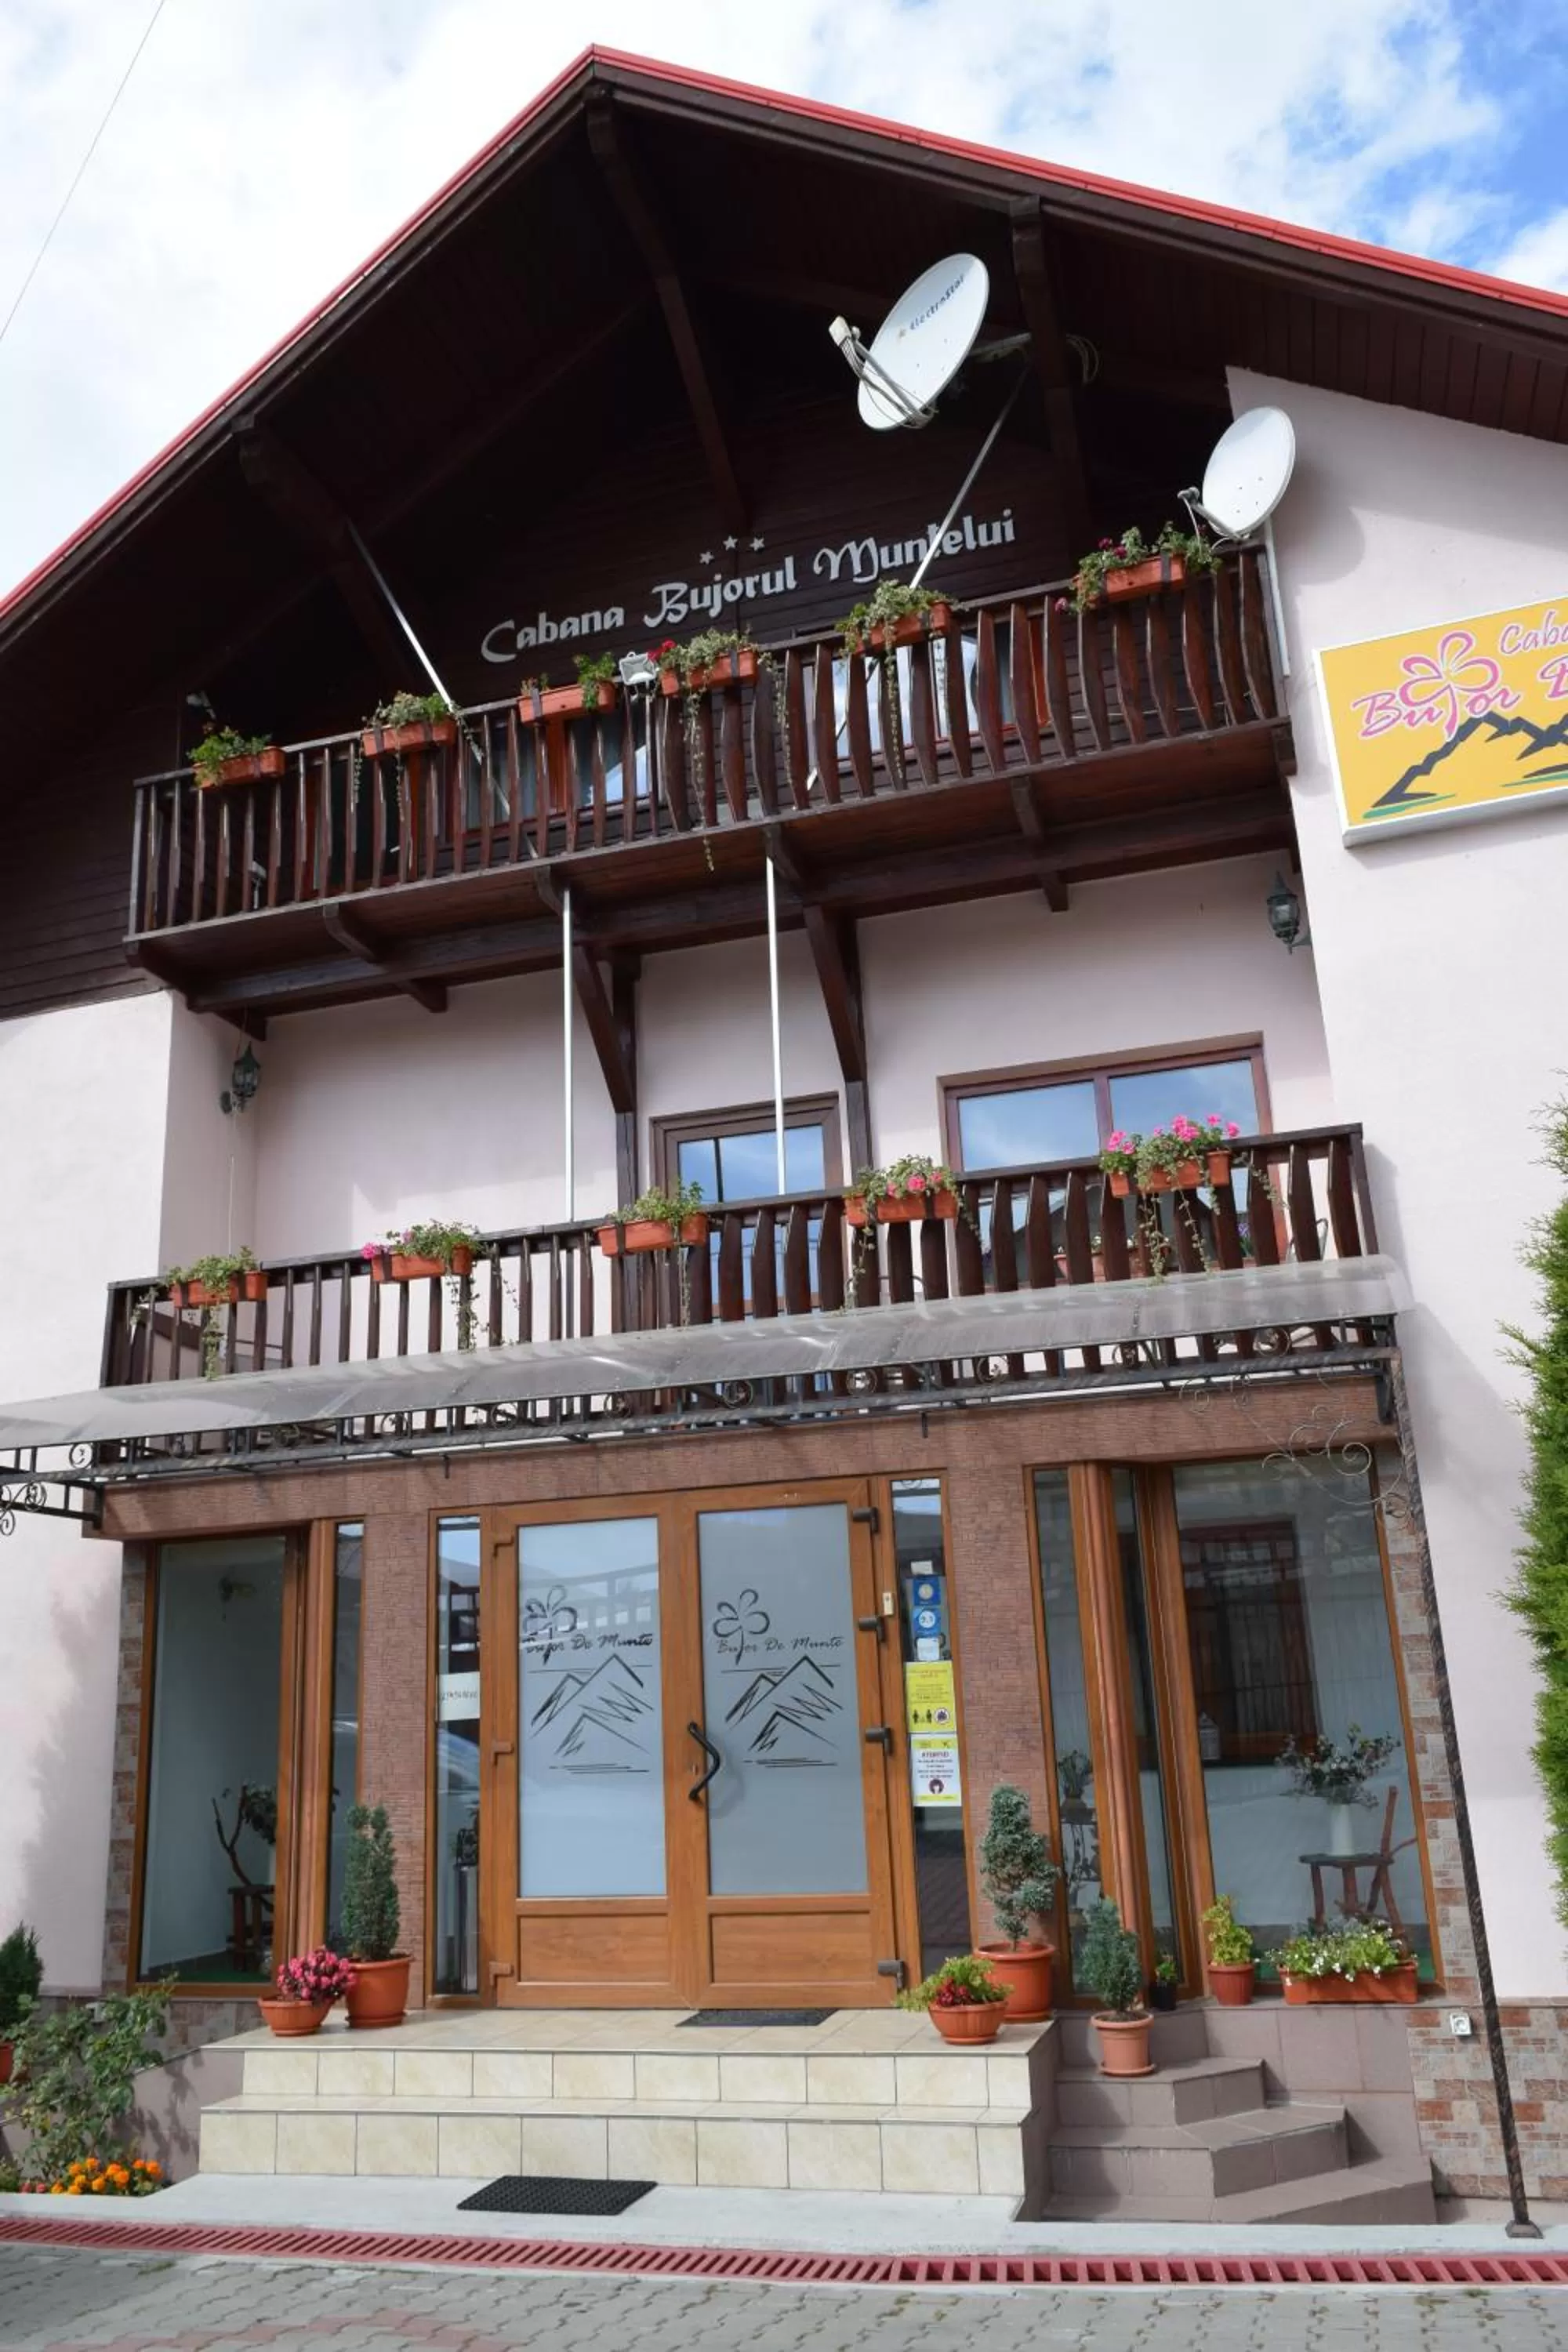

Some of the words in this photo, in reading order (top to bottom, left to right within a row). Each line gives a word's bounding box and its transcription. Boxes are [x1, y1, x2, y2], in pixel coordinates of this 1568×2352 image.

[481, 606, 625, 663] Cabana
[644, 557, 797, 627] Bujorul
[813, 508, 1015, 583] Muntelui
